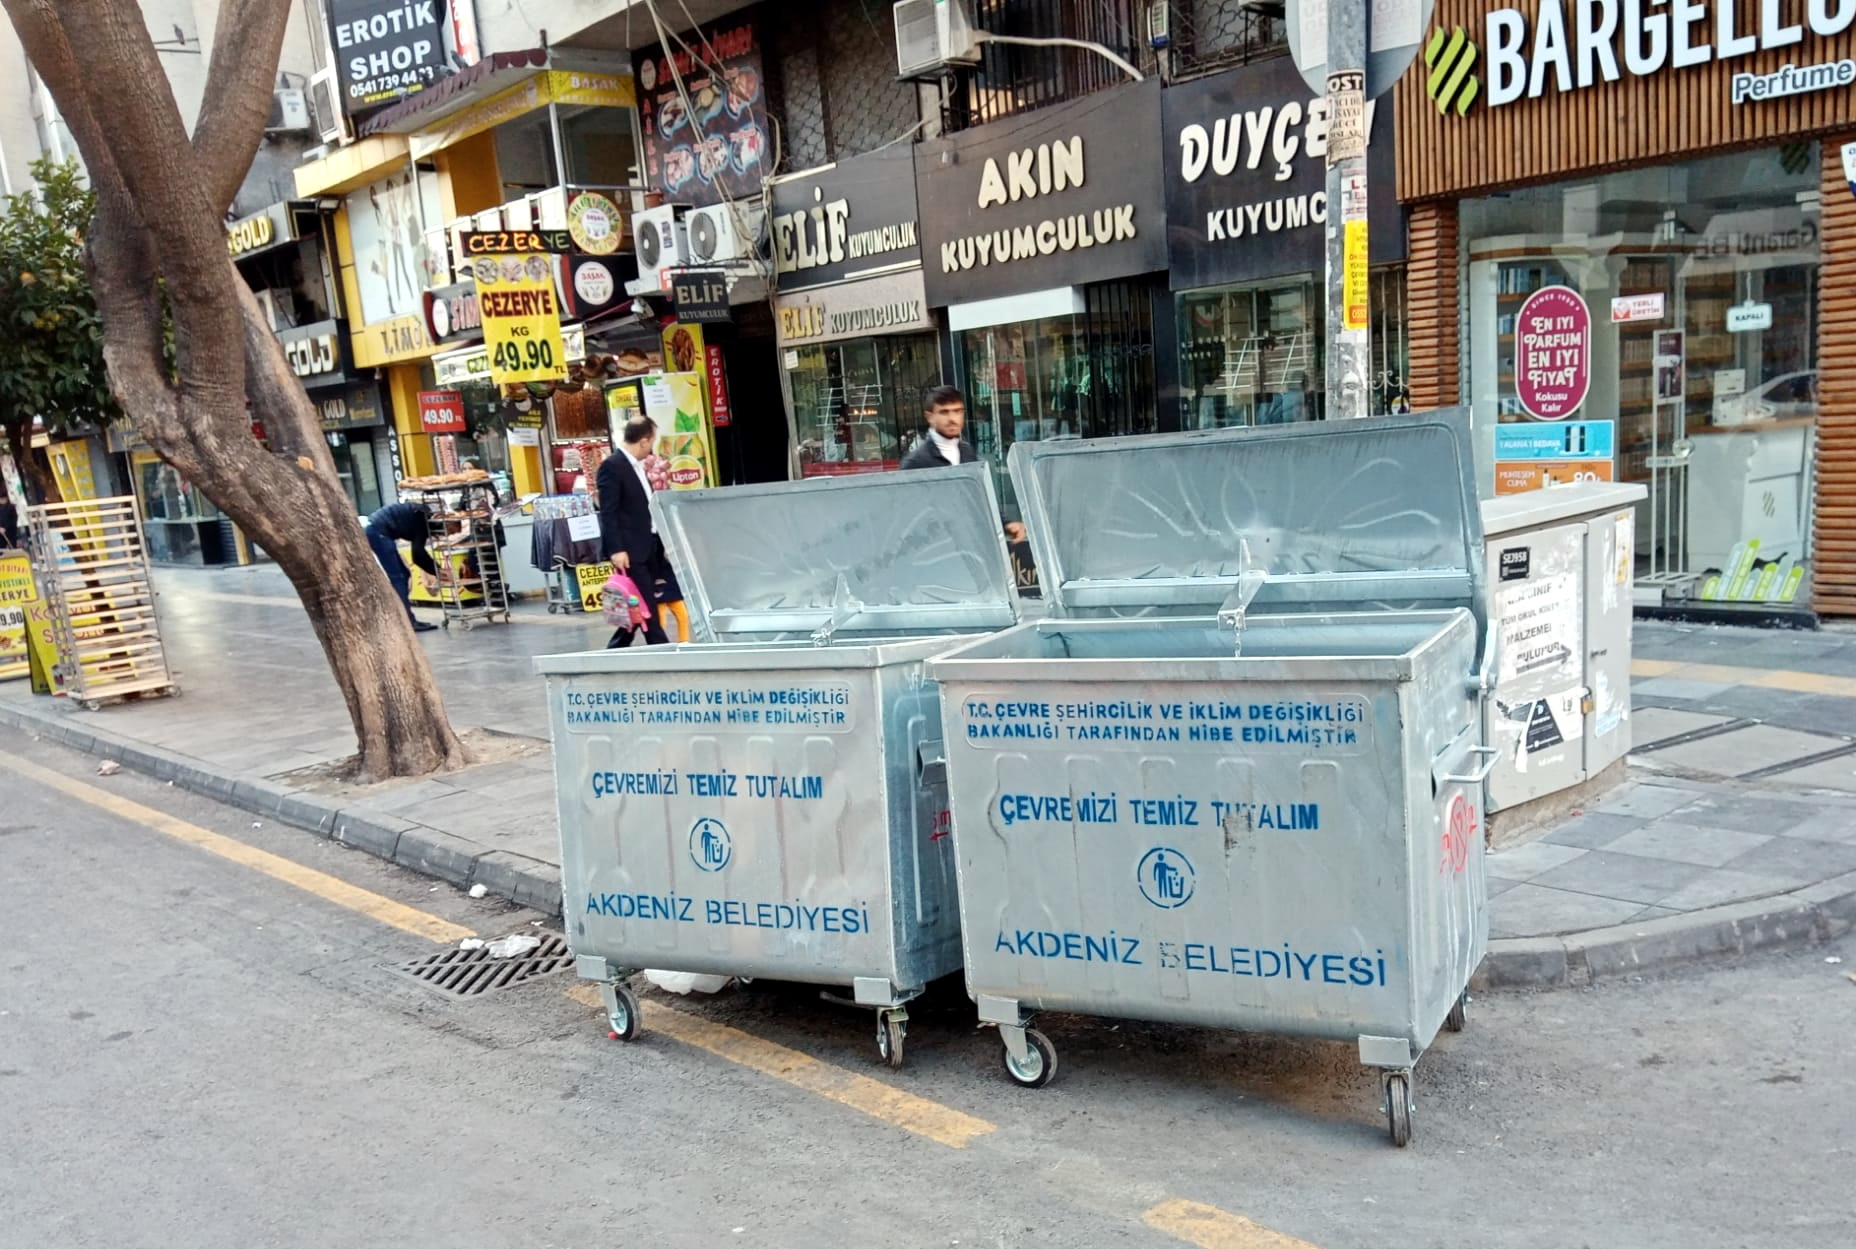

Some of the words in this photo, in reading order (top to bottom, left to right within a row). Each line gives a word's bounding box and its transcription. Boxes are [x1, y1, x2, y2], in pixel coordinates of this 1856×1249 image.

[335, 2, 436, 49] EROTİK
[350, 40, 432, 81] SHOP
[350, 80, 379, 98] 0541
[1733, 59, 1854, 102] Perfume
[1180, 97, 1376, 183] DUYÇE
[978, 135, 1084, 209] AKIN
[773, 186, 850, 274] ELİF
[848, 220, 917, 259] KUYUMCULUK
[1207, 191, 1328, 242] KUYUMC
[469, 231, 571, 253] CEZERYE
[941, 204, 1137, 274] KUYUMCULUK
[481, 290, 553, 318] CEZERYE
[676, 279, 725, 305] ELİF
[779, 295, 826, 340] ELİF
[831, 300, 920, 334] KUYUMCULUK
[1531, 316, 1553, 334] EN
[511, 326, 530, 338] KG
[1523, 332, 1582, 351] PARFUM
[493, 339, 554, 372] 49.90
[554, 363, 567, 375] TL
[1528, 350, 1551, 368] EN
[1527, 366, 1578, 390] FIYAT
[423, 407, 454, 425] 49.90
[672, 471, 699, 483] Lipton
[579, 564, 615, 579] CEZERY
[587, 692, 628, 709] ÇEVRE
[631, 689, 701, 709] ŞEHİRCİLİK
[705, 691, 723, 705] VE
[725, 689, 765, 705] İKLİM
[769, 688, 849, 708] DEĞİŞİKLİĞİ
[567, 708, 635, 724] BAKANLIĞI
[639, 710, 722, 724] TARAFINDAN
[727, 708, 760, 724] HİBE
[765, 708, 846, 728] EDİLMİŞTİR
[995, 703, 1050, 724] ÇEVRE
[1055, 701, 1154, 722] ŞEHİRCİLİK
[1160, 705, 1184, 721] VE
[1188, 701, 1242, 721] İKLİM
[1249, 701, 1364, 723] DEĞİŞİKLİĞİ
[967, 721, 1060, 740] BAKANLIĞI
[1068, 725, 1180, 742] TARAFINDAN
[1188, 722, 1234, 742] HİBE
[1241, 725, 1358, 748] EDİLMİŞTİR
[592, 768, 679, 799] ÇEVREMİZİ
[686, 768, 738, 797] TEMİZ
[745, 775, 823, 799] TUTALIM
[999, 792, 1118, 826] ÇEVREMİZİ
[1129, 794, 1200, 826] TEMİZ
[586, 890, 695, 922] AKDENİZ
[706, 898, 870, 934] BELEDİYESİ
[994, 929, 1143, 966] AKDENİZ
